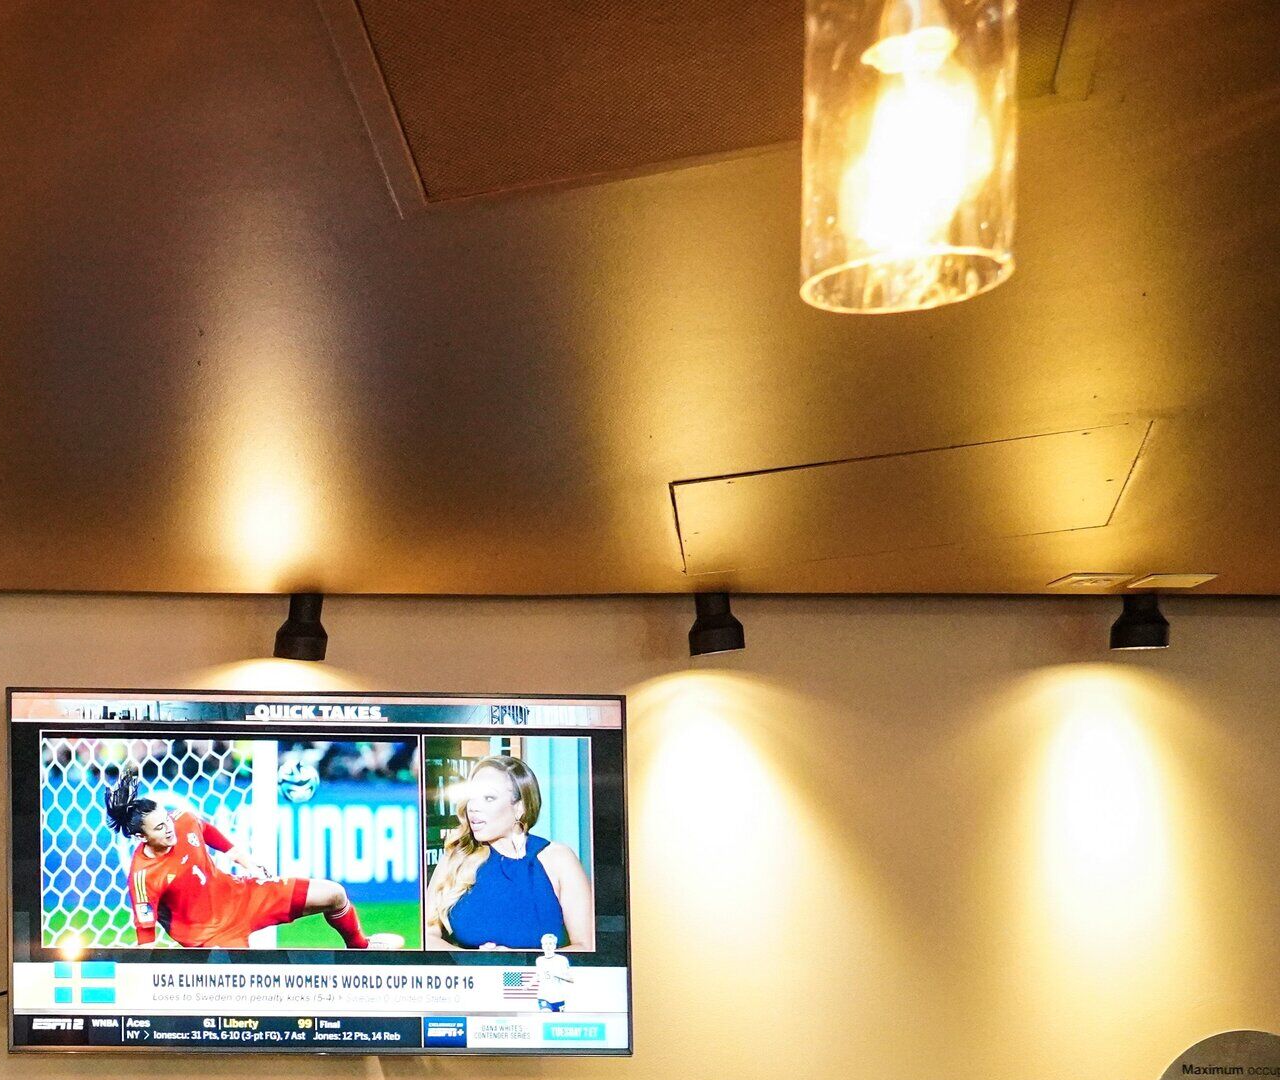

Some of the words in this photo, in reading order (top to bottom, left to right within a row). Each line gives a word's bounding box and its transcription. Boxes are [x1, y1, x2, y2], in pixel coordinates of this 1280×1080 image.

[254, 704, 316, 721] QUICK
[320, 705, 381, 719] TAKES
[153, 974, 175, 988] USA
[179, 974, 246, 988] ELIMINATED
[250, 975, 282, 988] FROM
[285, 975, 338, 988] WOMEN'S
[342, 975, 383, 989] WORLD
[387, 975, 408, 989] CUP
[410, 976, 423, 989] IN
[426, 976, 442, 989] RD
[445, 976, 460, 989] OF
[463, 976, 474, 989] 16
[91, 1018, 119, 1028] WNBA
[127, 1018, 151, 1028] Aces
[203, 1018, 216, 1028] 61
[223, 1018, 259, 1030] Liberty
[297, 1018, 313, 1028] 99
[320, 1019, 341, 1029] Final
[127, 1031, 141, 1040] NY
[1182, 1064, 1244, 1075] Maximum
